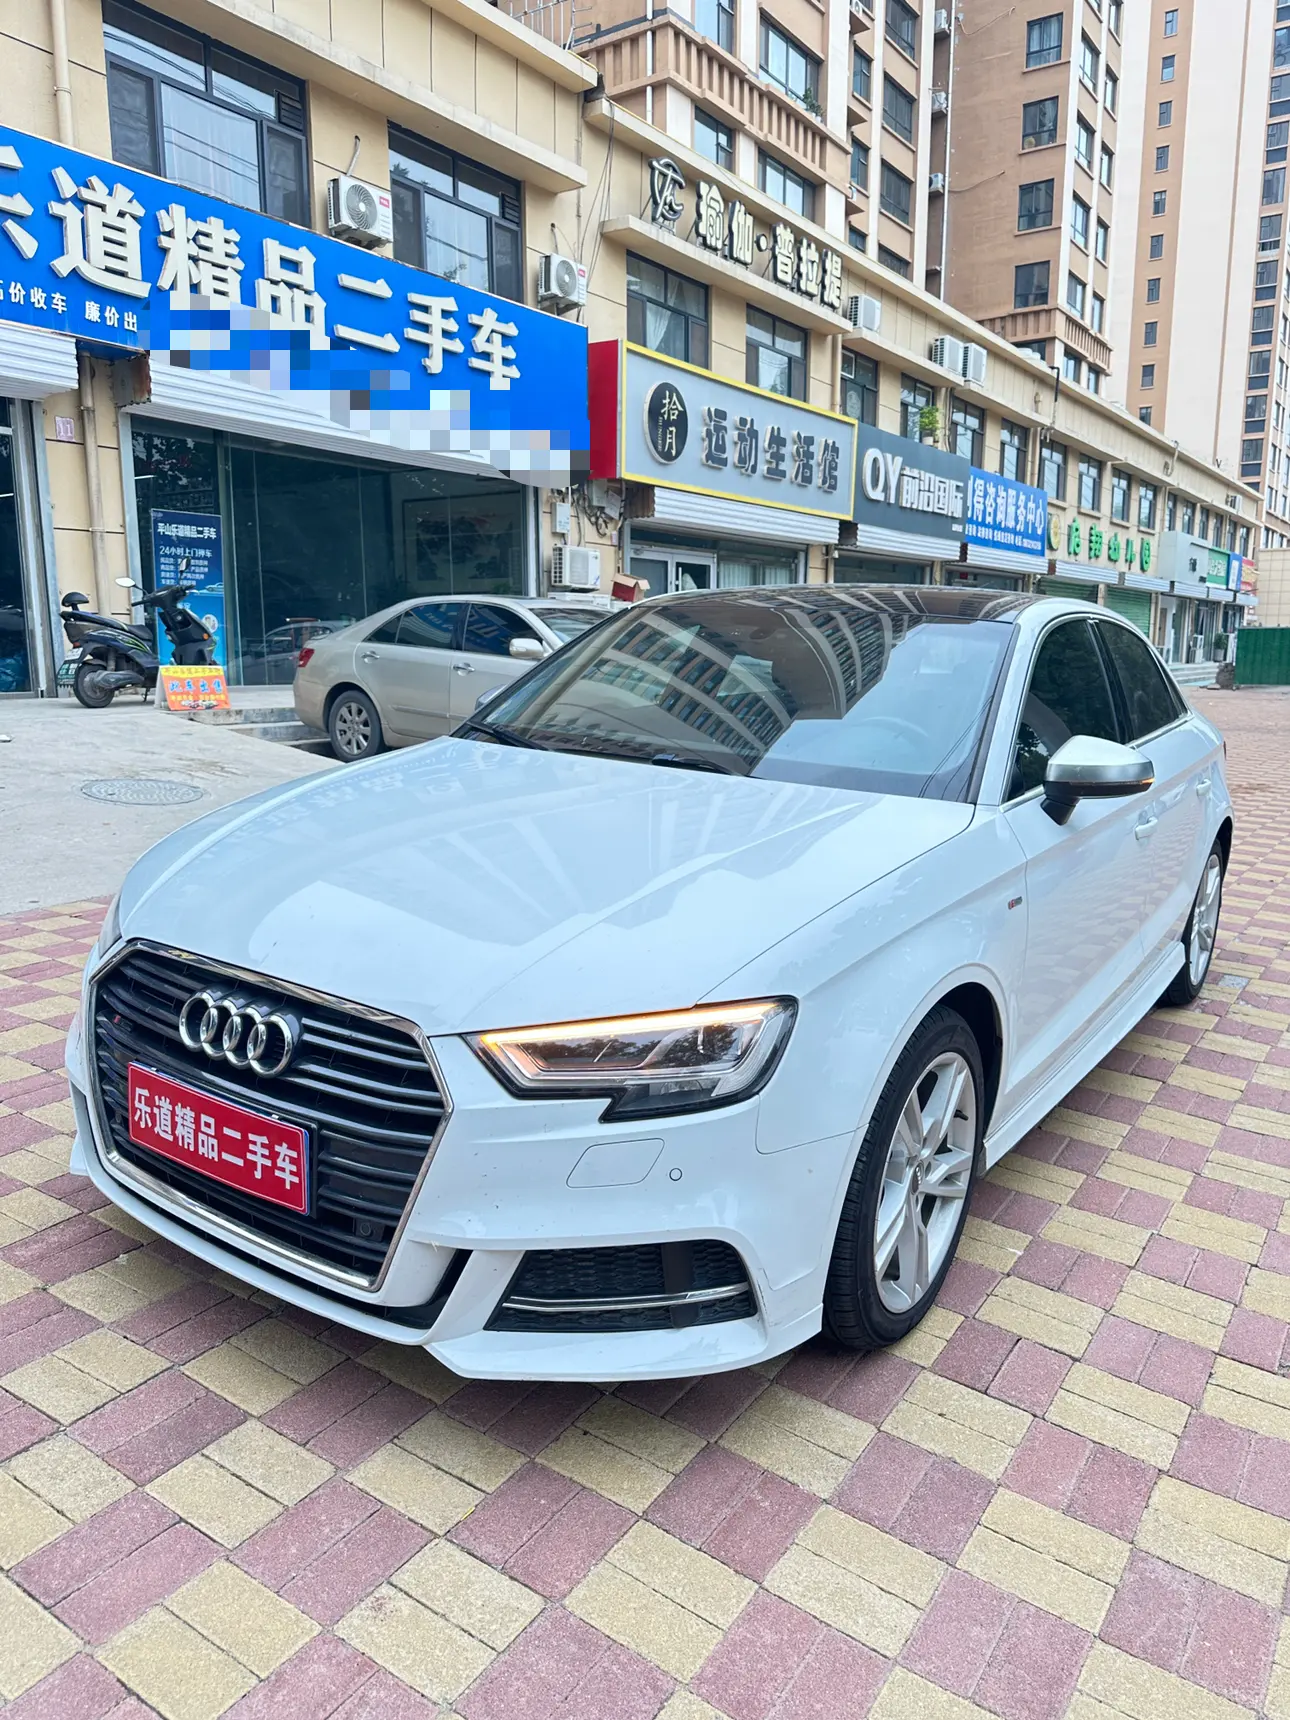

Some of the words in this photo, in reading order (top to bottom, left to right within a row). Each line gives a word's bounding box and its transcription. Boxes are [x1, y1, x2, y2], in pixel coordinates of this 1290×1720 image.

[696, 179, 843, 310] 瑜伽·普拉提
[0, 281, 67, 314] 价收车
[660, 389, 684, 457] 拾月
[702, 406, 840, 493] 运动生活馆
[862, 447, 903, 504] QY
[900, 466, 964, 519] 前沿国际
[133, 1087, 299, 1190] 乐道精品二手车
